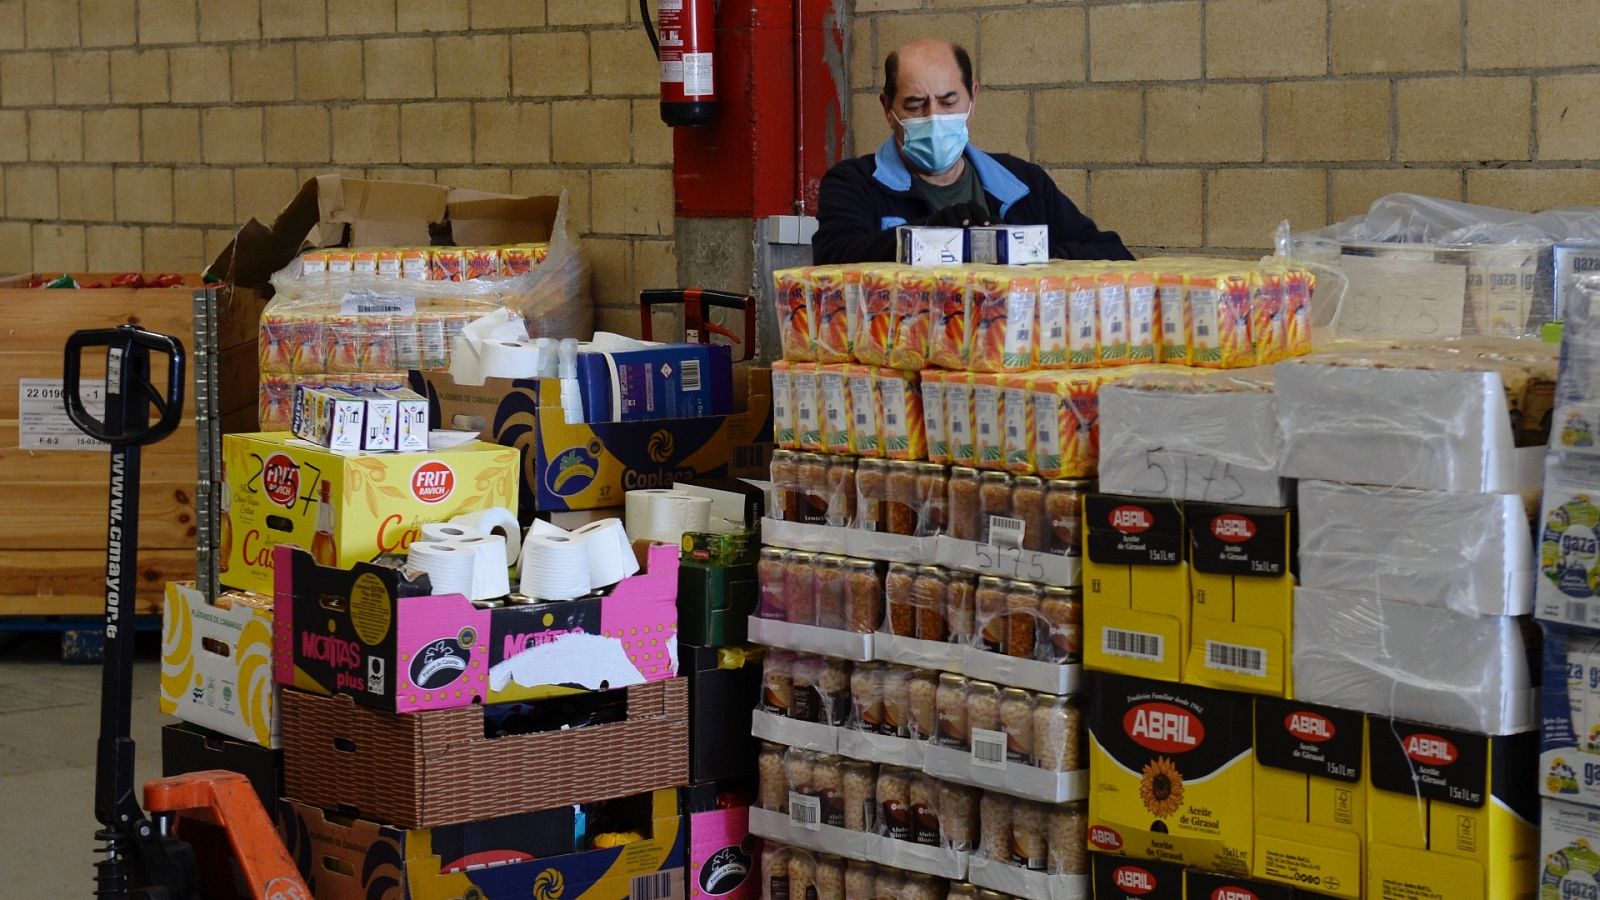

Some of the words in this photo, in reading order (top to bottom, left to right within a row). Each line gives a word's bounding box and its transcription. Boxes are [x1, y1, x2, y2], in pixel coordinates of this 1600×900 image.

[1489, 272, 1517, 290] gaza
[26, 388, 39, 398] 22
[416, 470, 450, 487] FRIT
[1133, 446, 1244, 500] 5175
[1113, 510, 1150, 528] ABRIL
[1215, 519, 1252, 537] ABRIL
[376, 514, 421, 552] Ca
[1562, 533, 1597, 555] gaza
[975, 543, 1045, 579] 5175
[336, 671, 365, 691] plus
[1131, 709, 1196, 745] ABRIL
[1289, 714, 1331, 738] ABRIL
[1407, 736, 1453, 761] ABRIL
[1584, 762, 1600, 786] ga
[1180, 814, 1190, 824] de
[1191, 816, 1220, 829] Girasol
[1188, 805, 1212, 817] Aceite
[1091, 828, 1120, 847] ABRIL
[1116, 869, 1152, 890] ABRIL
[1562, 879, 1597, 900] gaza
